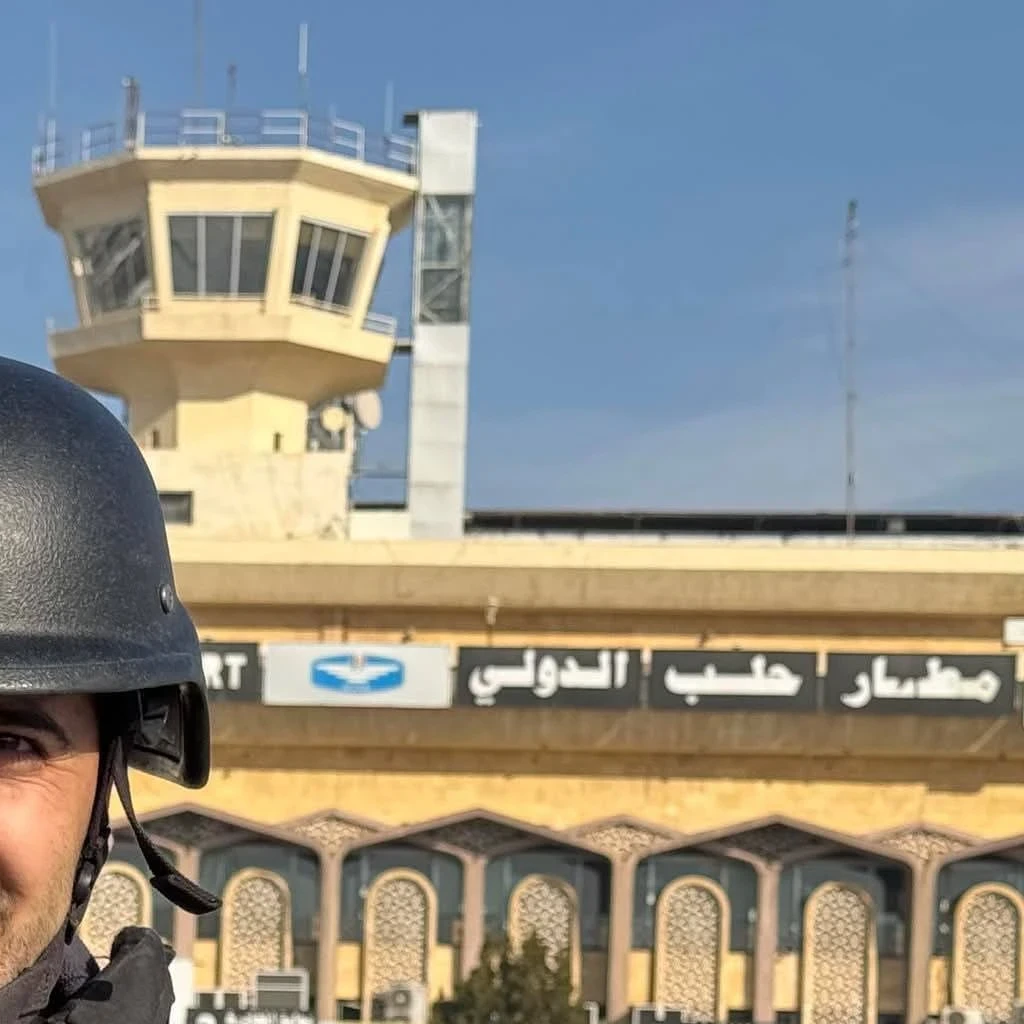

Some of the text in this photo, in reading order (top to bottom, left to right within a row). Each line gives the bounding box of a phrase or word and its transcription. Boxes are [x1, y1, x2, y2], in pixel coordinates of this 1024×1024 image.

[468, 648, 1001, 708] مطار حلب الدولي
